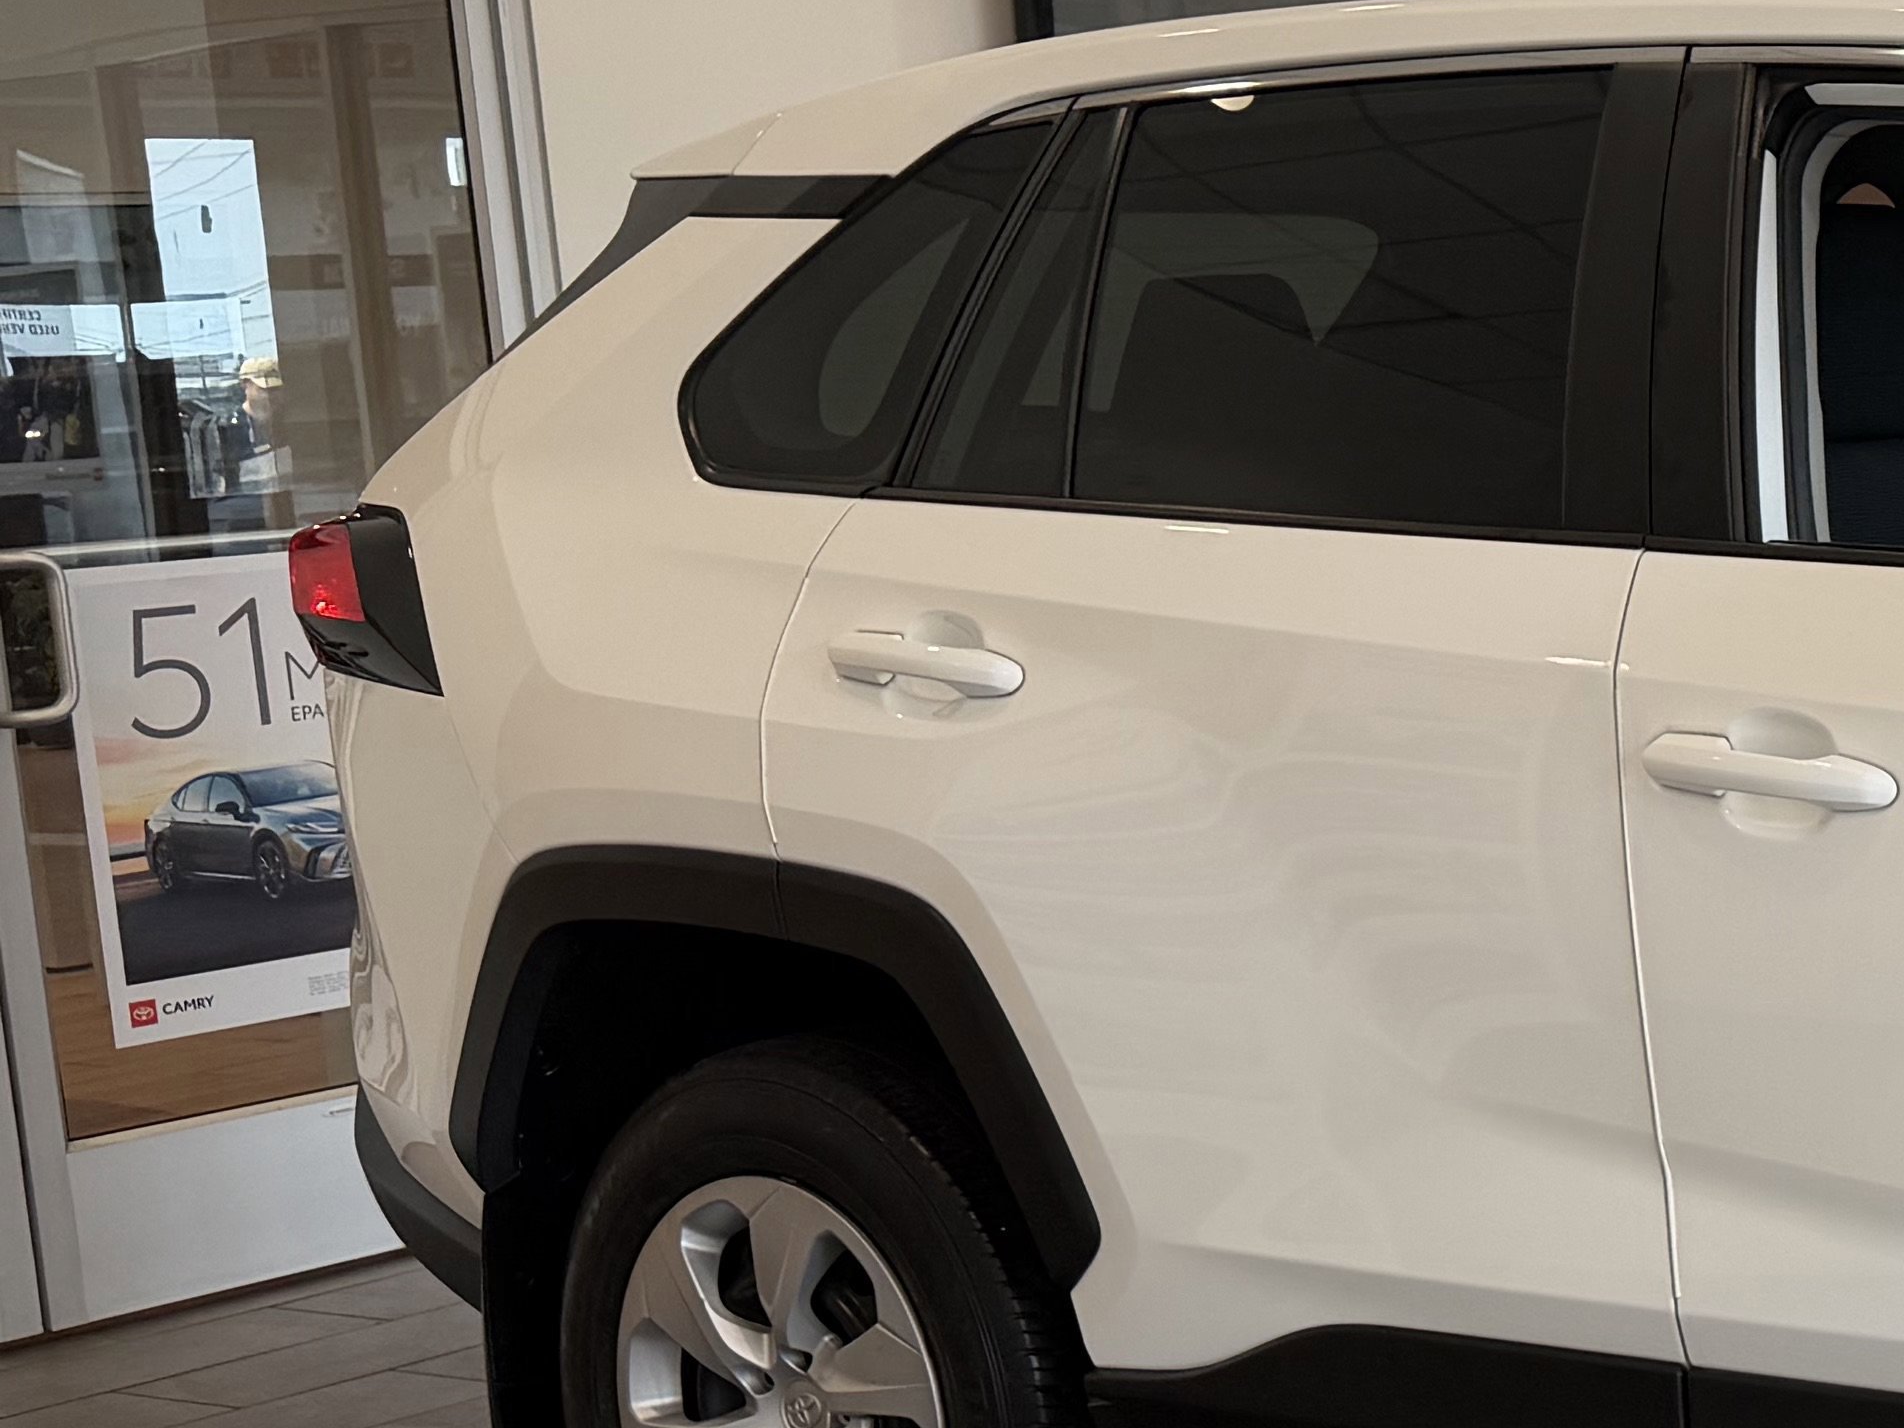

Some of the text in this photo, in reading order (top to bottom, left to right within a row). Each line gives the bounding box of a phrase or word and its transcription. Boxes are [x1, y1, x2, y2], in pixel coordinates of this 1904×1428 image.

[131, 597, 271, 739] 51
[291, 703, 325, 722] EPA
[162, 995, 214, 1015] CAMRY
